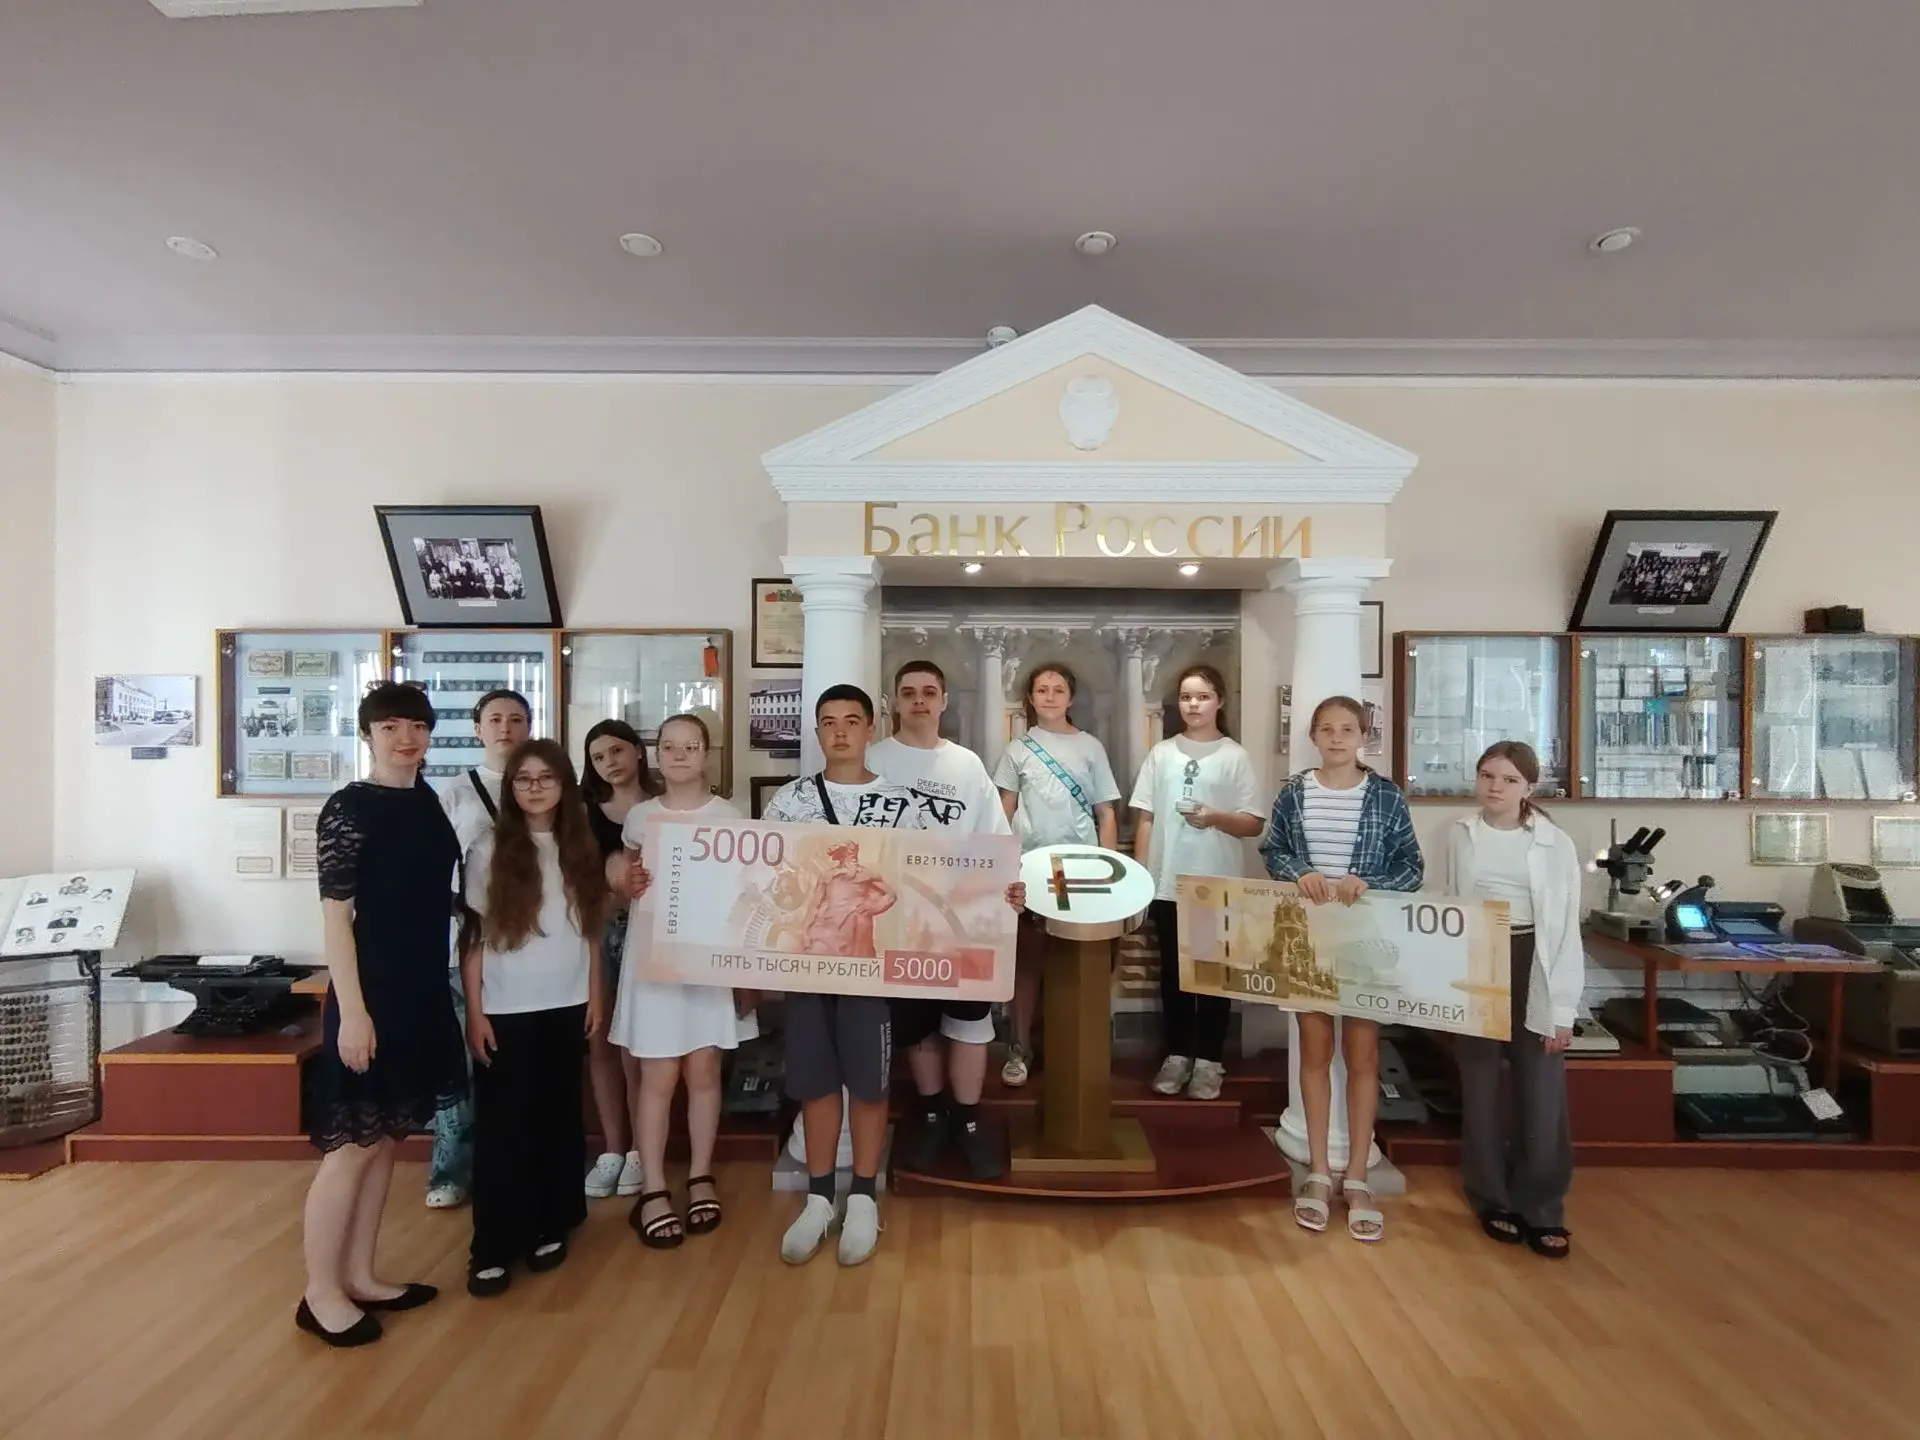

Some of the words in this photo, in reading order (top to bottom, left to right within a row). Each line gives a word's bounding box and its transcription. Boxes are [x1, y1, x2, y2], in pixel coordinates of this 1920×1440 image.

[863, 501, 1031, 556] Банк
[1055, 501, 1312, 558] России
[917, 777, 939, 787] DEEP
[940, 783, 956, 791] SEA
[689, 826, 785, 867] 5000
[1401, 903, 1465, 938] 100
[711, 953, 752, 970] ПЯТЬ
[756, 956, 811, 974] ТЫСЯЧ
[817, 960, 881, 978] РУБЛЕЙ
[891, 957, 952, 981] 5000
[1241, 973, 1276, 994] 100
[1355, 993, 1389, 1010] СТО
[1397, 999, 1465, 1022] РУБЛЕЙ
